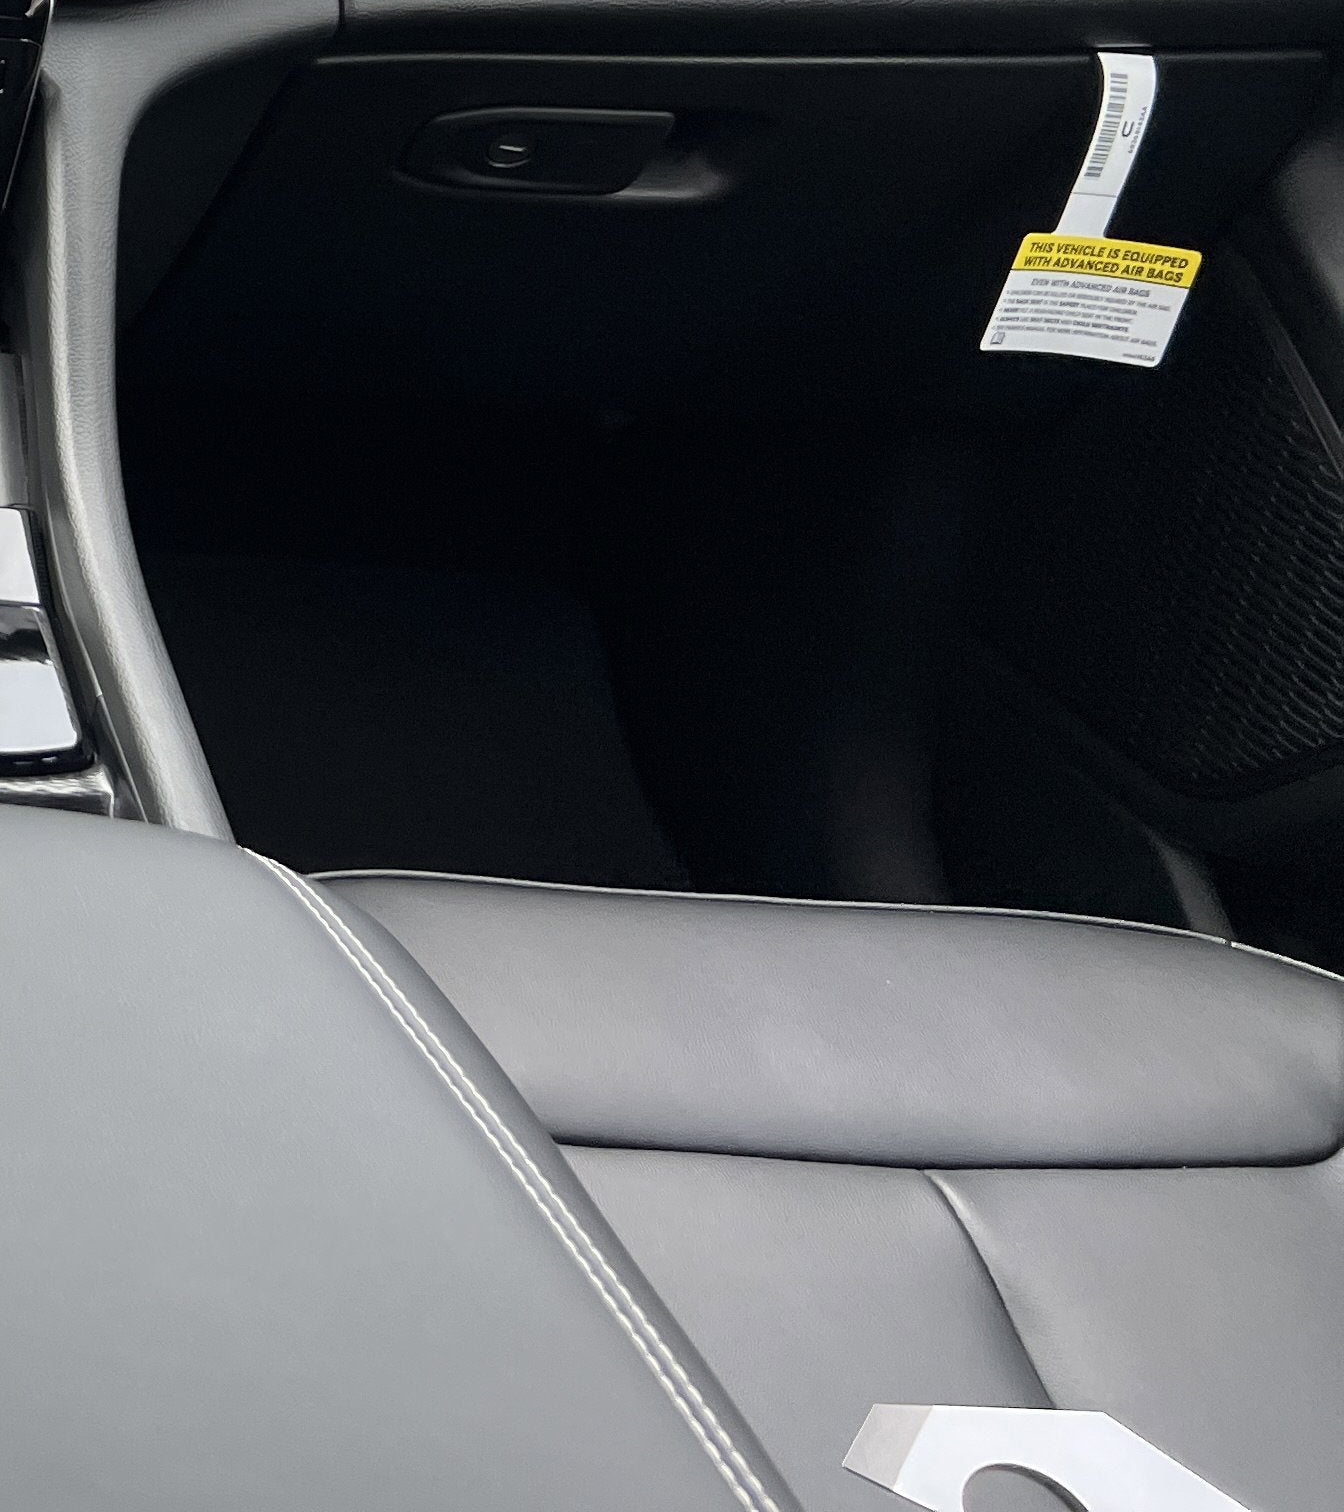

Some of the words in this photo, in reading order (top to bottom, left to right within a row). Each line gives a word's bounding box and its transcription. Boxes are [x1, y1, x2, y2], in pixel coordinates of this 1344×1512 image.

[1030, 242, 1053, 254] THIS
[1056, 243, 1105, 258] VEHICLE
[1108, 248, 1121, 259] IS
[1122, 249, 1190, 269] EQUIPPED
[1023, 256, 1051, 267] WITH
[1052, 257, 1119, 274] ADVANCED
[1120, 265, 1145, 277] AIR
[1146, 268, 1184, 283] BAGS
